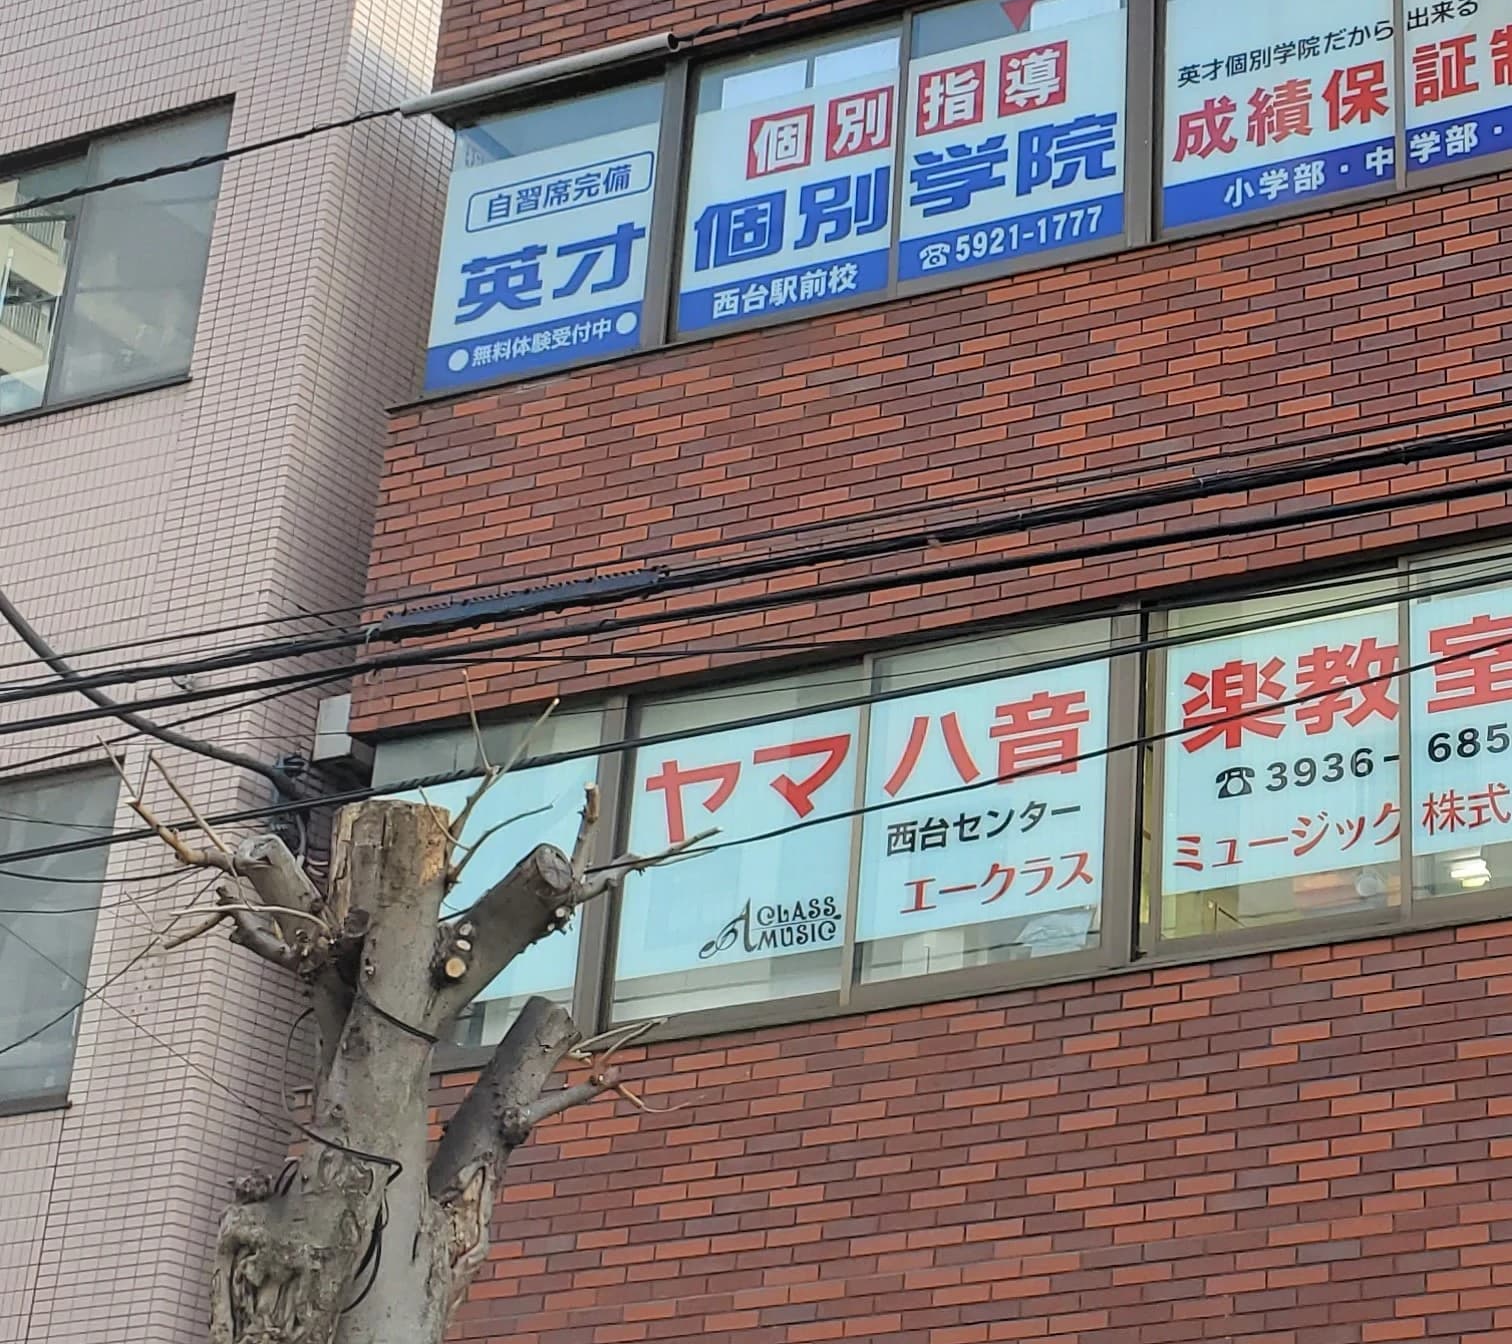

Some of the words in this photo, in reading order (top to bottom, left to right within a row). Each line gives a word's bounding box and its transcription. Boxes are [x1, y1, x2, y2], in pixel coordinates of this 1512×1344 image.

[752, 47, 1065, 172] 個別指導
[485, 164, 632, 222] 自習席完備
[711, 262, 859, 320] 西台駅前校
[470, 317, 612, 368] 無料体験受付中
[887, 799, 1081, 857] 西台センター
[757, 895, 837, 926] CLASS
[757, 920, 837, 951] MUSIC
